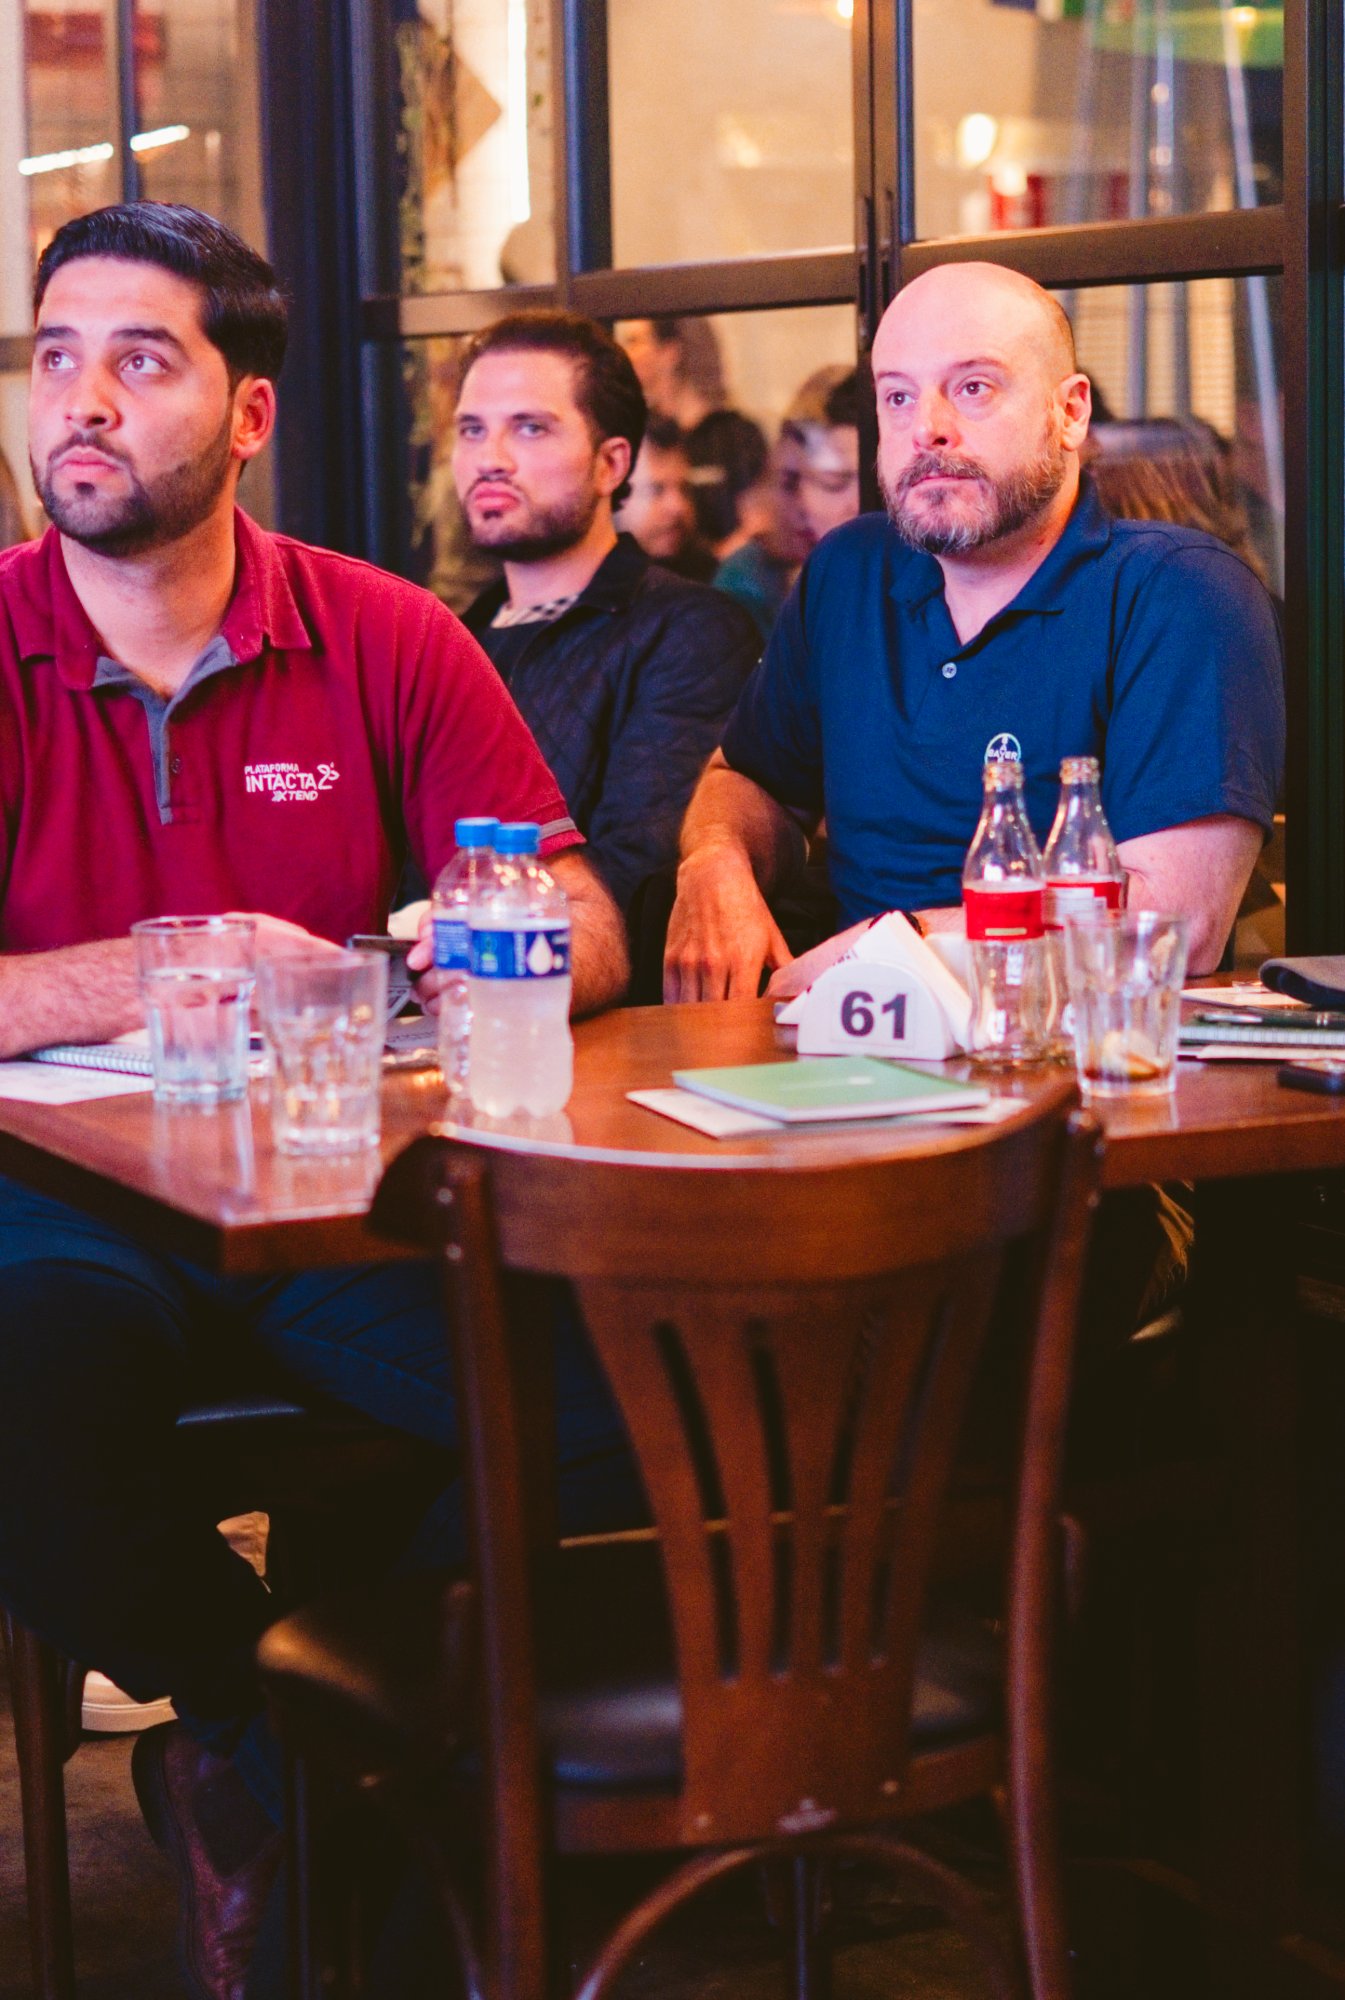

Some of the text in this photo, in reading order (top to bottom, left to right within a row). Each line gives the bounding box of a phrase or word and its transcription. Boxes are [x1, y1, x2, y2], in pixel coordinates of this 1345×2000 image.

[987, 748, 1018, 761] BAYER
[244, 763, 300, 774] PLATAFORMA
[245, 772, 317, 792] INTACTA
[271, 790, 318, 802] XTEND
[841, 990, 907, 1040] 61
